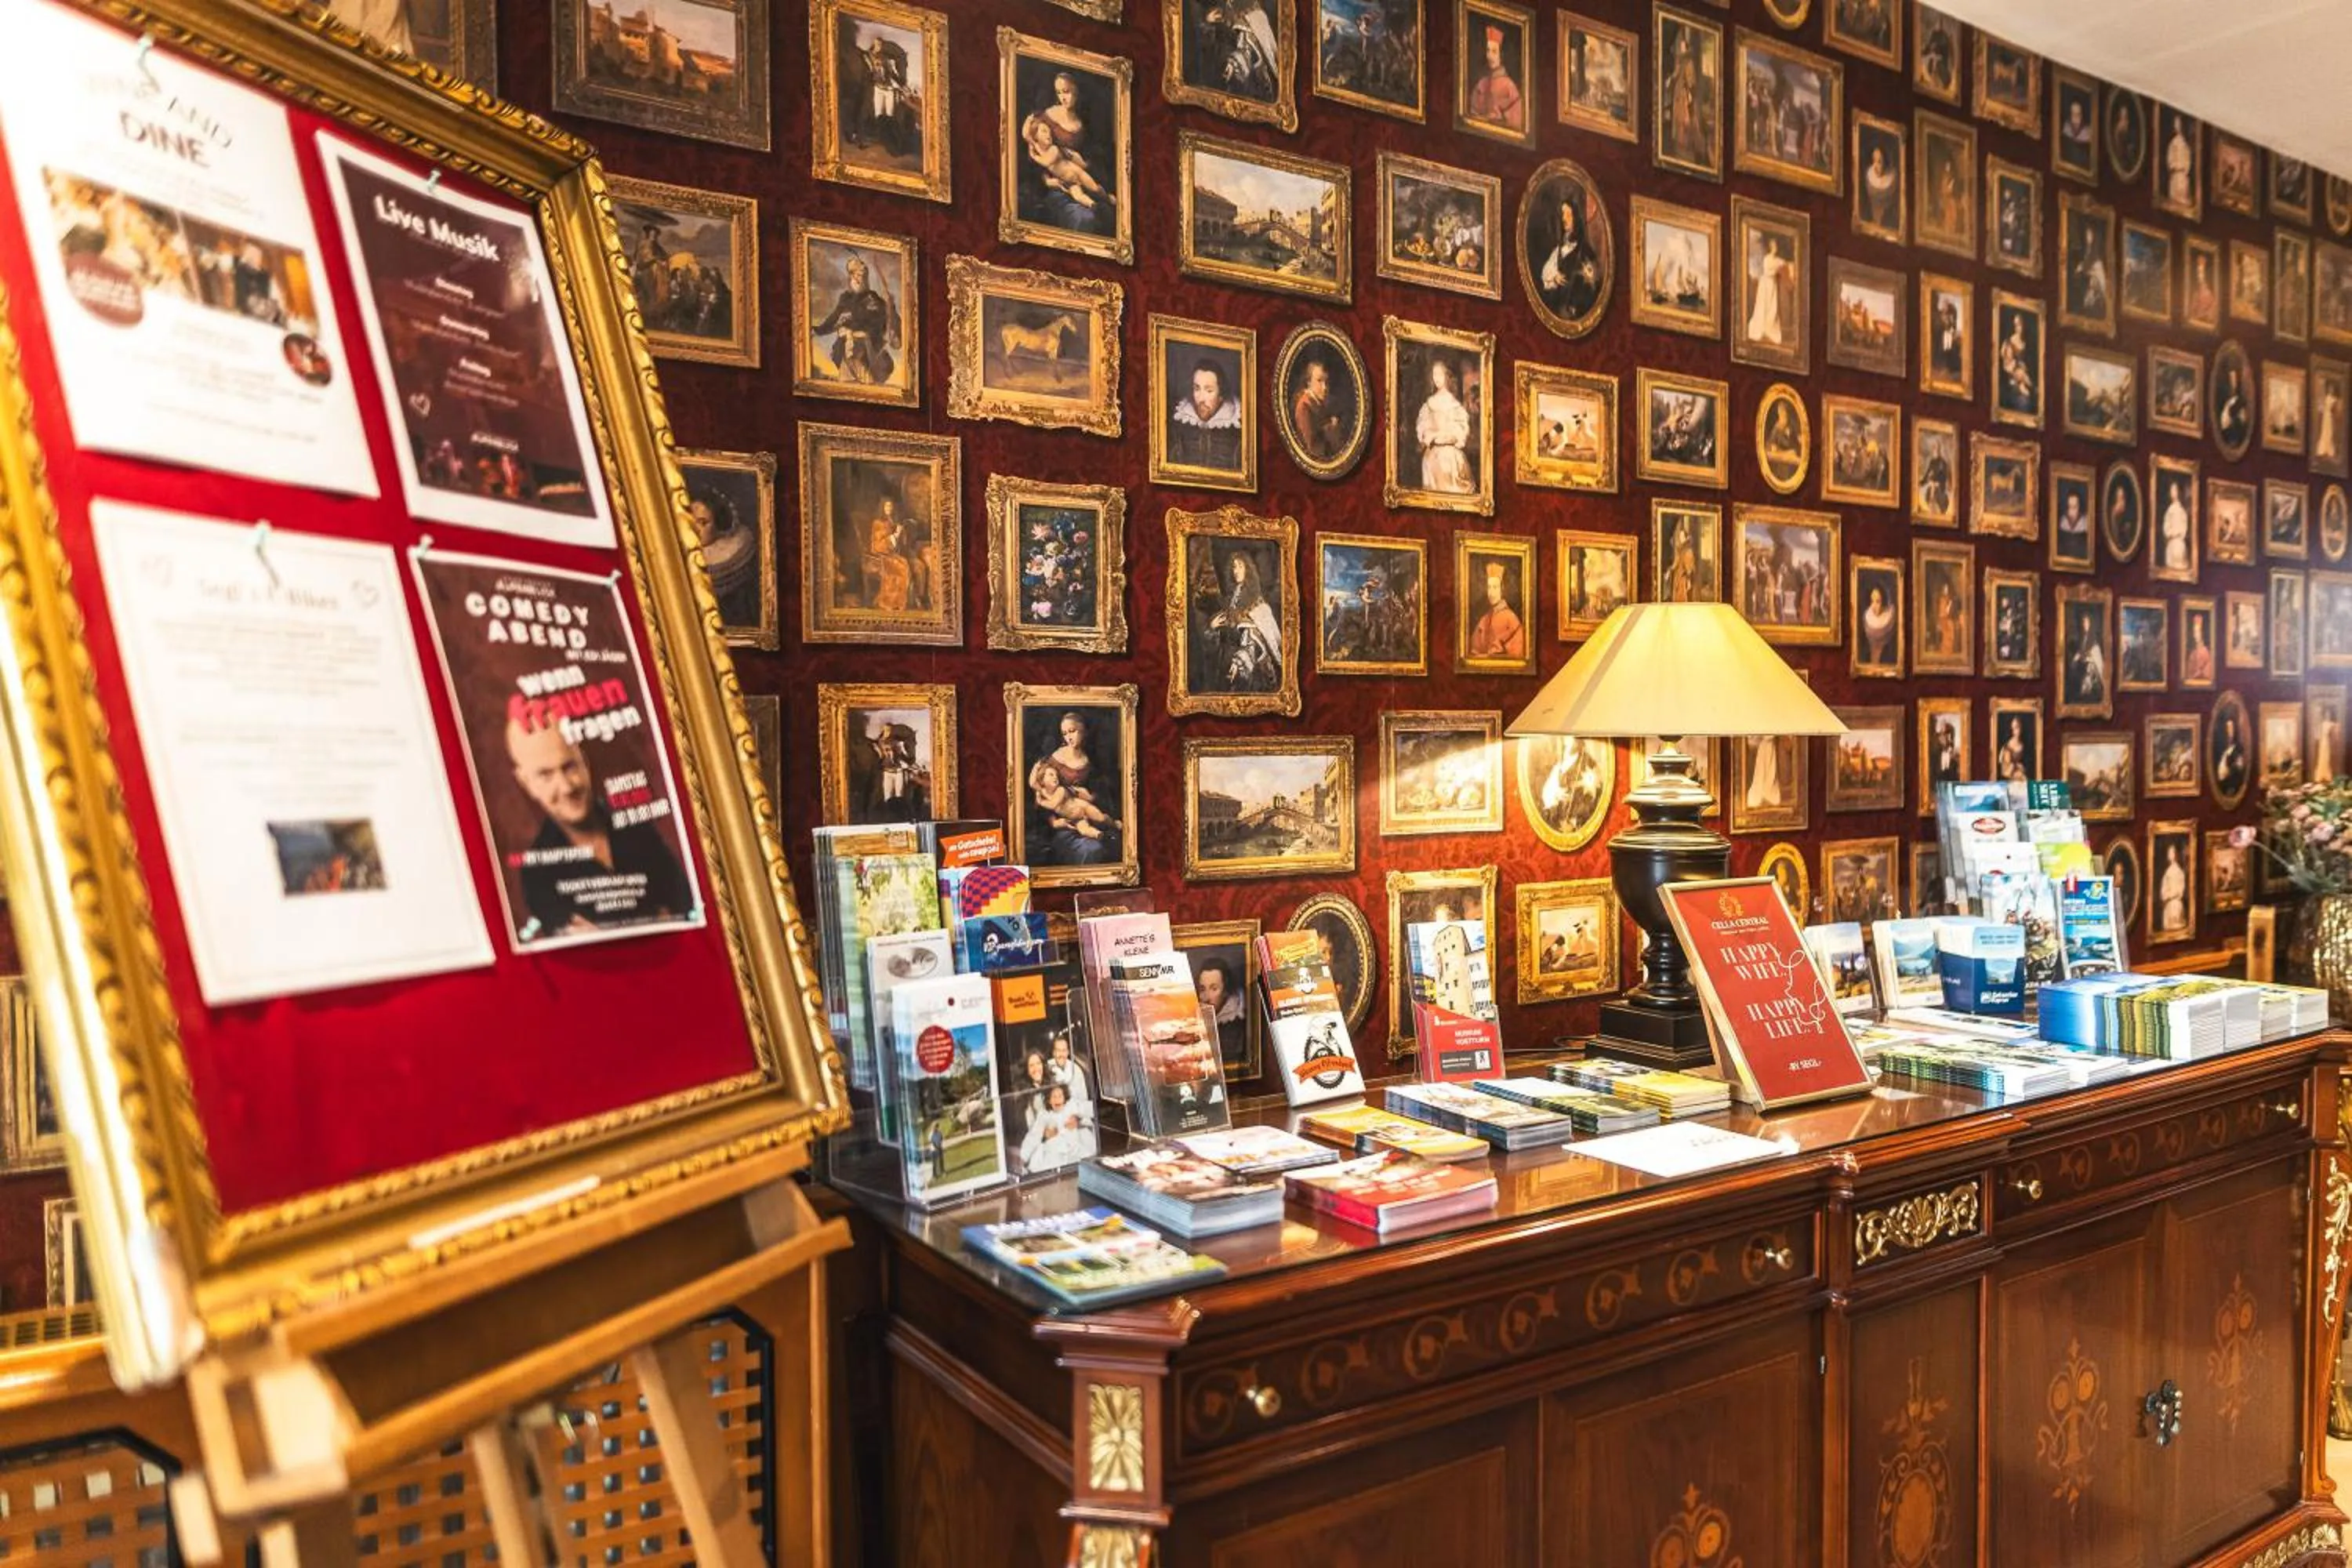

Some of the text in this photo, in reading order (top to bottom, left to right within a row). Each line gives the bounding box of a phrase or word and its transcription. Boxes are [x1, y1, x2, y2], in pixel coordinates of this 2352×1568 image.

[120, 111, 211, 169] DINE
[374, 194, 500, 262] Live Musik
[465, 592, 589, 627] COMEDY
[488, 619, 587, 649] ABEND
[506, 677, 628, 735] frauen
[559, 706, 642, 745] fragen
[1719, 942, 1781, 964] HAPPY
[1745, 997, 1806, 1021] HAPPY
